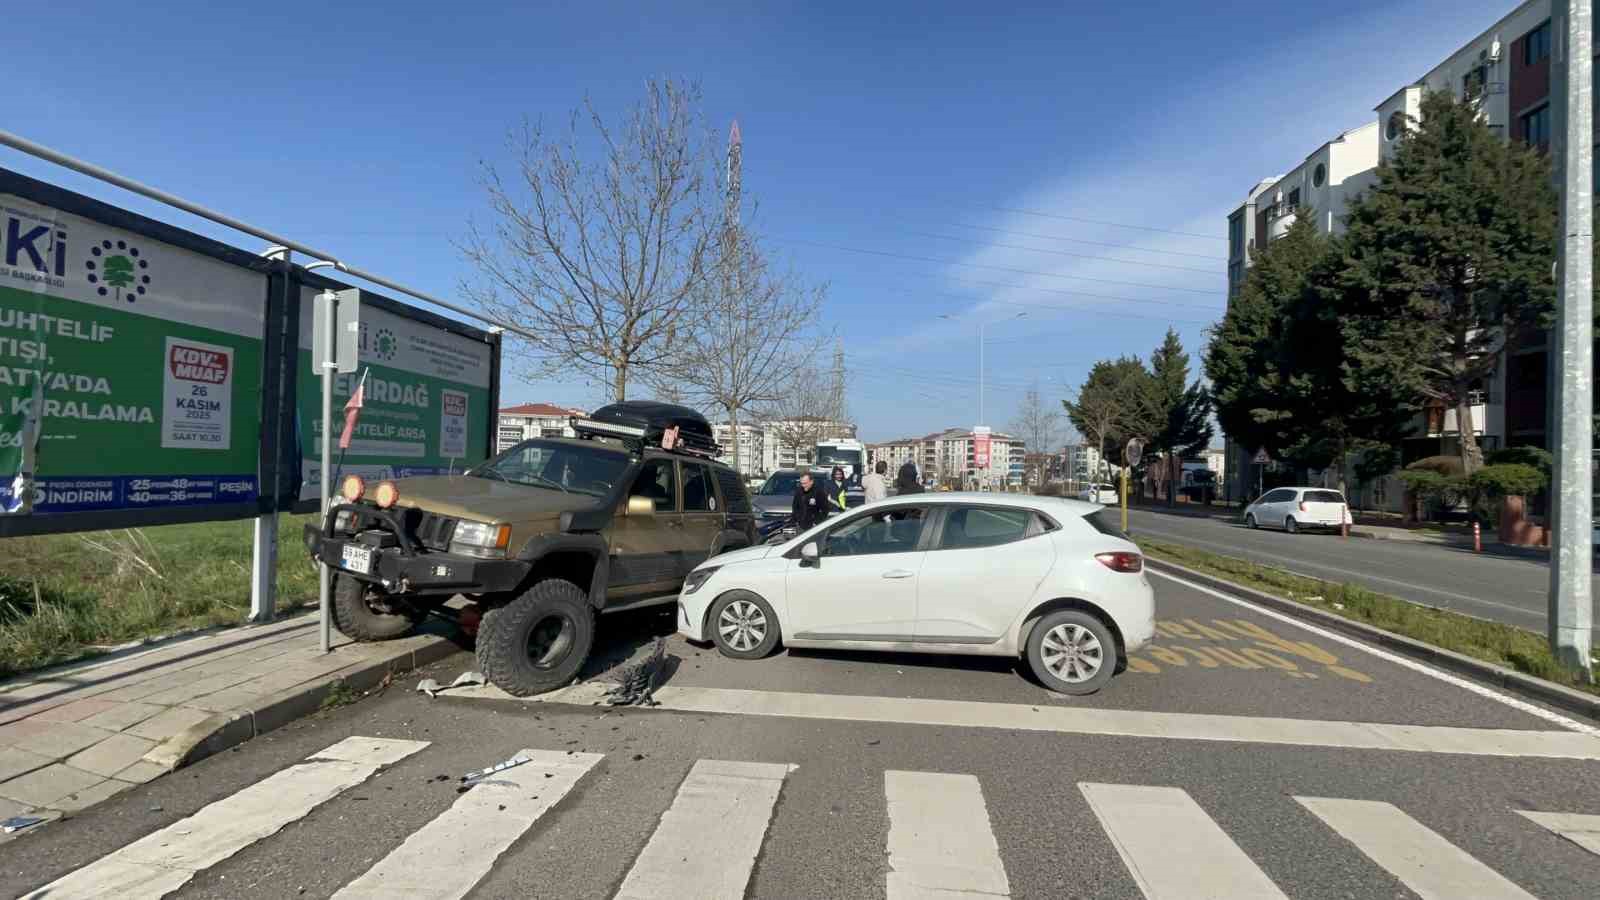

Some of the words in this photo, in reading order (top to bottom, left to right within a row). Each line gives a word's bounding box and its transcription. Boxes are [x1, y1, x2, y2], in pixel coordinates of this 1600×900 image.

[0, 216, 67, 277] Ki
[175, 364, 225, 381] MUAF
[192, 385, 208, 396] 26
[321, 372, 429, 408] EKİRDAĞ
[11, 396, 155, 424] KRALAMA
[176, 398, 221, 411] KASIM
[173, 432, 197, 441] SAAT
[333, 424, 397, 438] MHTELİF
[48, 488, 113, 503] İNDİRİM
